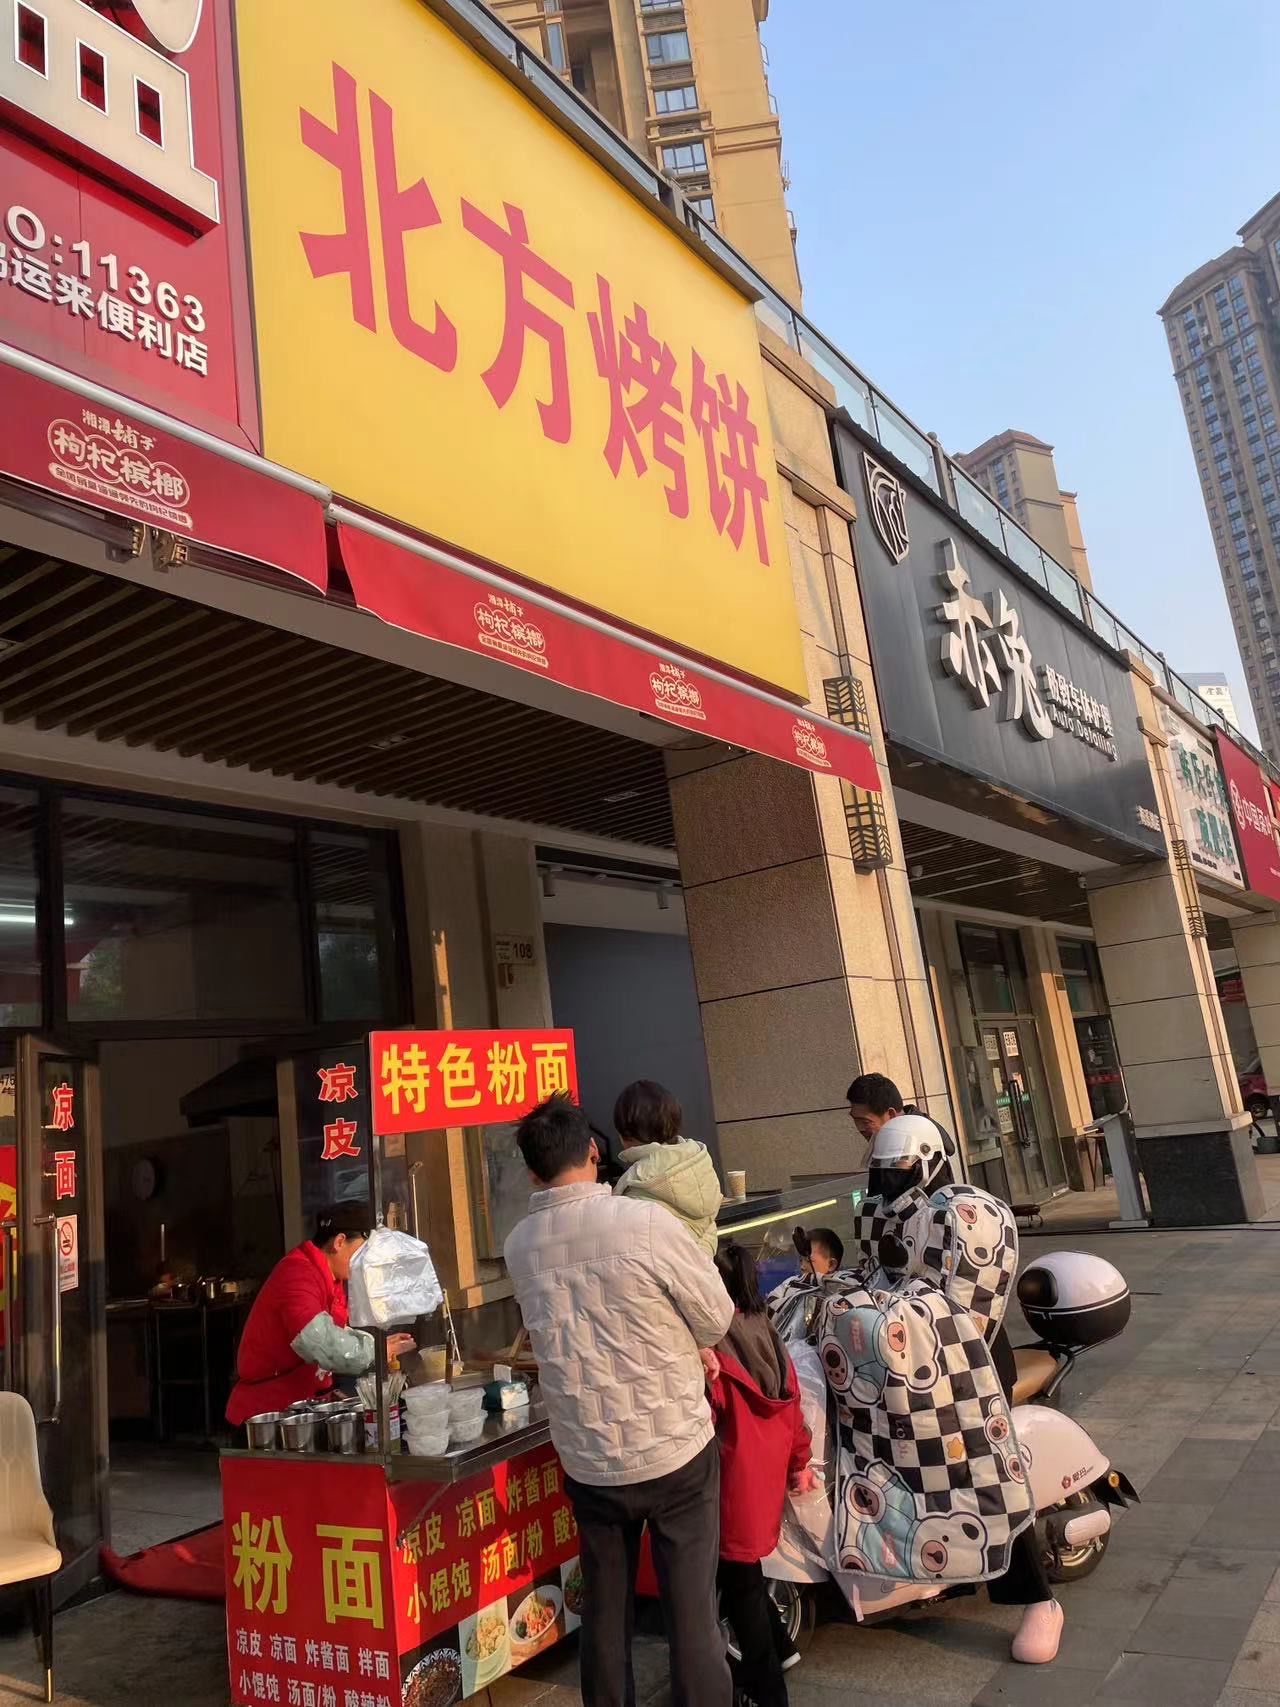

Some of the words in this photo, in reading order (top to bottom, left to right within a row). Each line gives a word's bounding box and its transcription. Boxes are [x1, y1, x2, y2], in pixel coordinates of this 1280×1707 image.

[0, 242, 208, 376] 运来便利店
[299, 61, 769, 567] 北方烤饼
[54, 427, 184, 500] 枸杞槟榔
[513, 943, 533, 959] 108
[317, 1063, 361, 1160] 凉皮
[380, 1041, 569, 1115] 特色粉面
[52, 1082, 76, 1200] 凉面
[456, 1488, 497, 1538] 凉面
[506, 1459, 560, 1516] 炸酱面
[407, 1558, 472, 1625] 小馄饨
[482, 1518, 544, 1585] 汤面/粉
[236, 1628, 263, 1659] 凉皮
[269, 1633, 298, 1665] 凉面
[304, 1639, 351, 1674] 炸酱面
[358, 1647, 391, 1682] 拌面
[239, 1669, 281, 1703] 小馄饨
